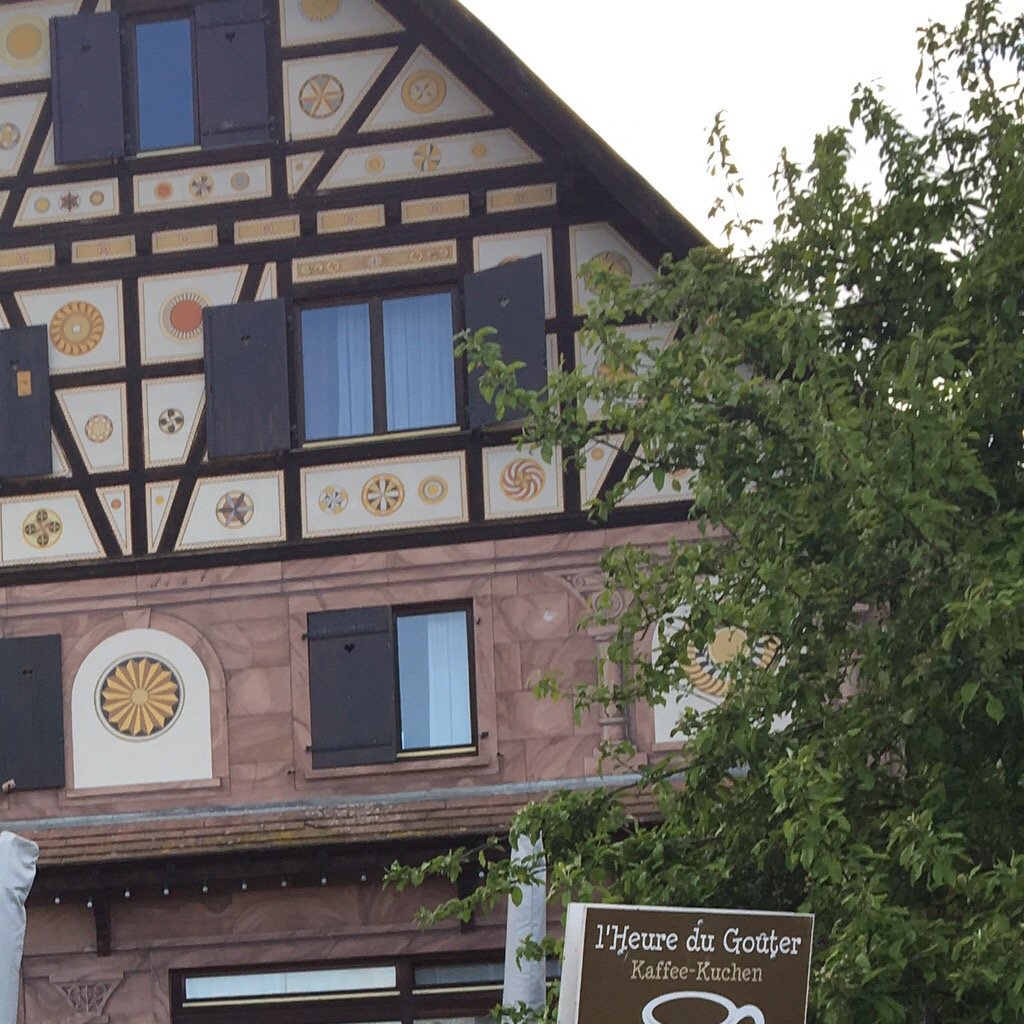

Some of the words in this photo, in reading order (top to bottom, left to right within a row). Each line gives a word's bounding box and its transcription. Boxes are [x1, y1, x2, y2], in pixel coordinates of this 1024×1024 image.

[686, 925, 715, 952] du
[723, 928, 802, 956] Goûter
[630, 959, 763, 982] Kaffee-Kuchen
